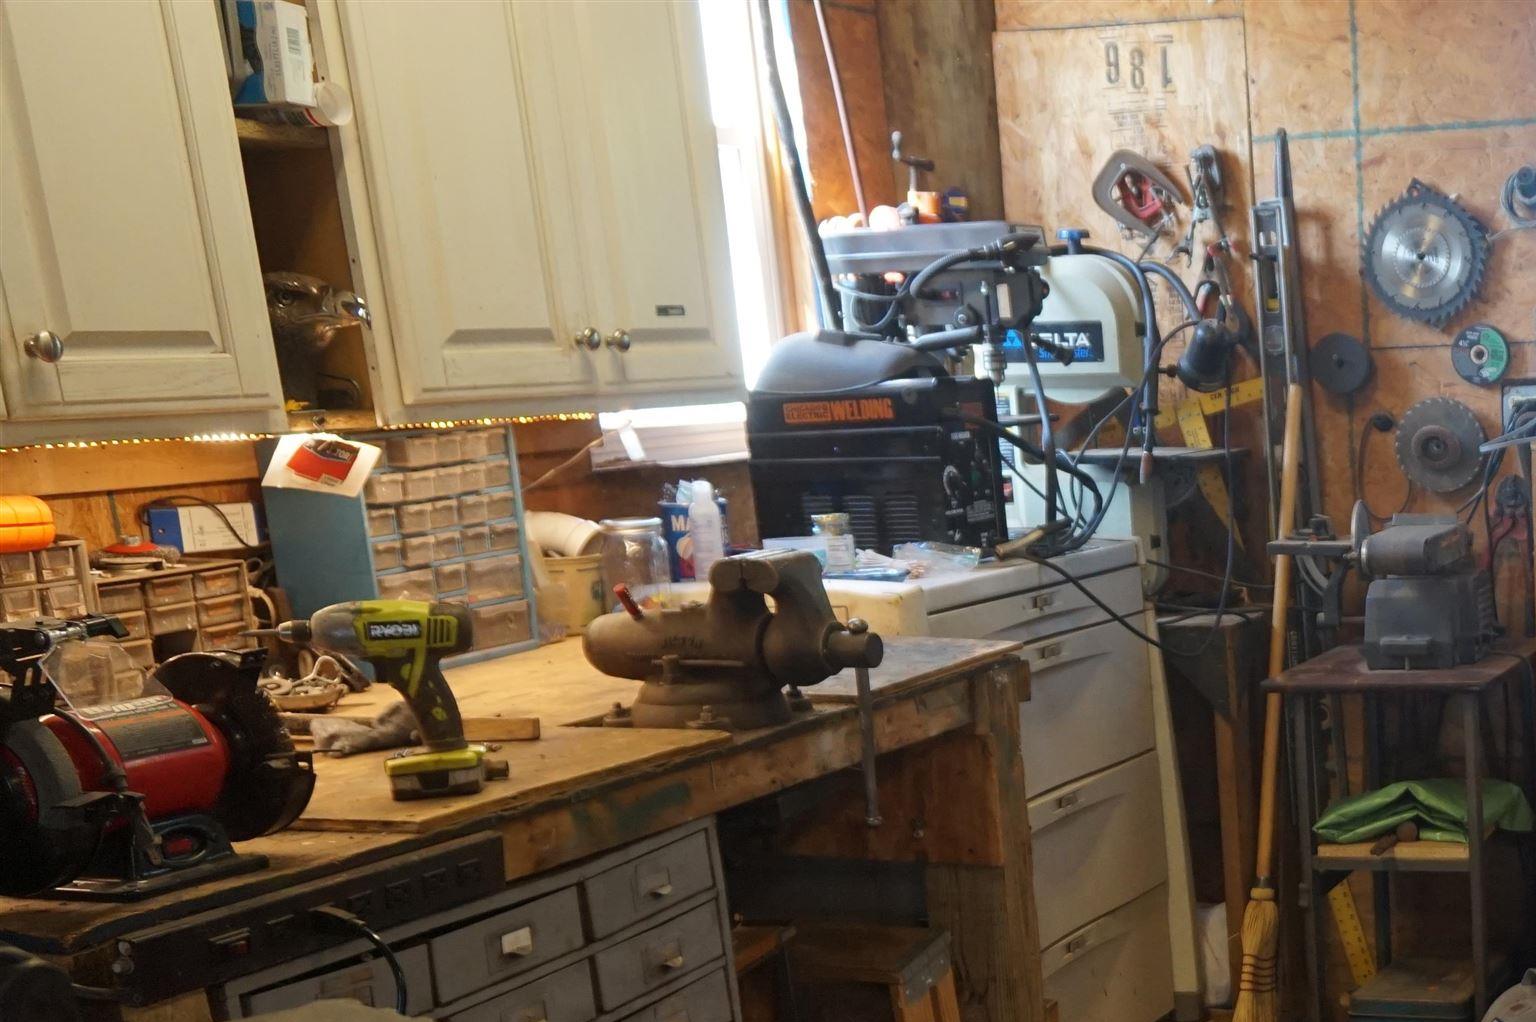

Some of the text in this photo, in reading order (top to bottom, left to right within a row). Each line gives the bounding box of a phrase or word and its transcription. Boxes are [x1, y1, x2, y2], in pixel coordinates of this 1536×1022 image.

[1030, 332, 1090, 347] ELTA
[831, 398, 894, 420] WELDING
[370, 623, 420, 637] RYOBI
